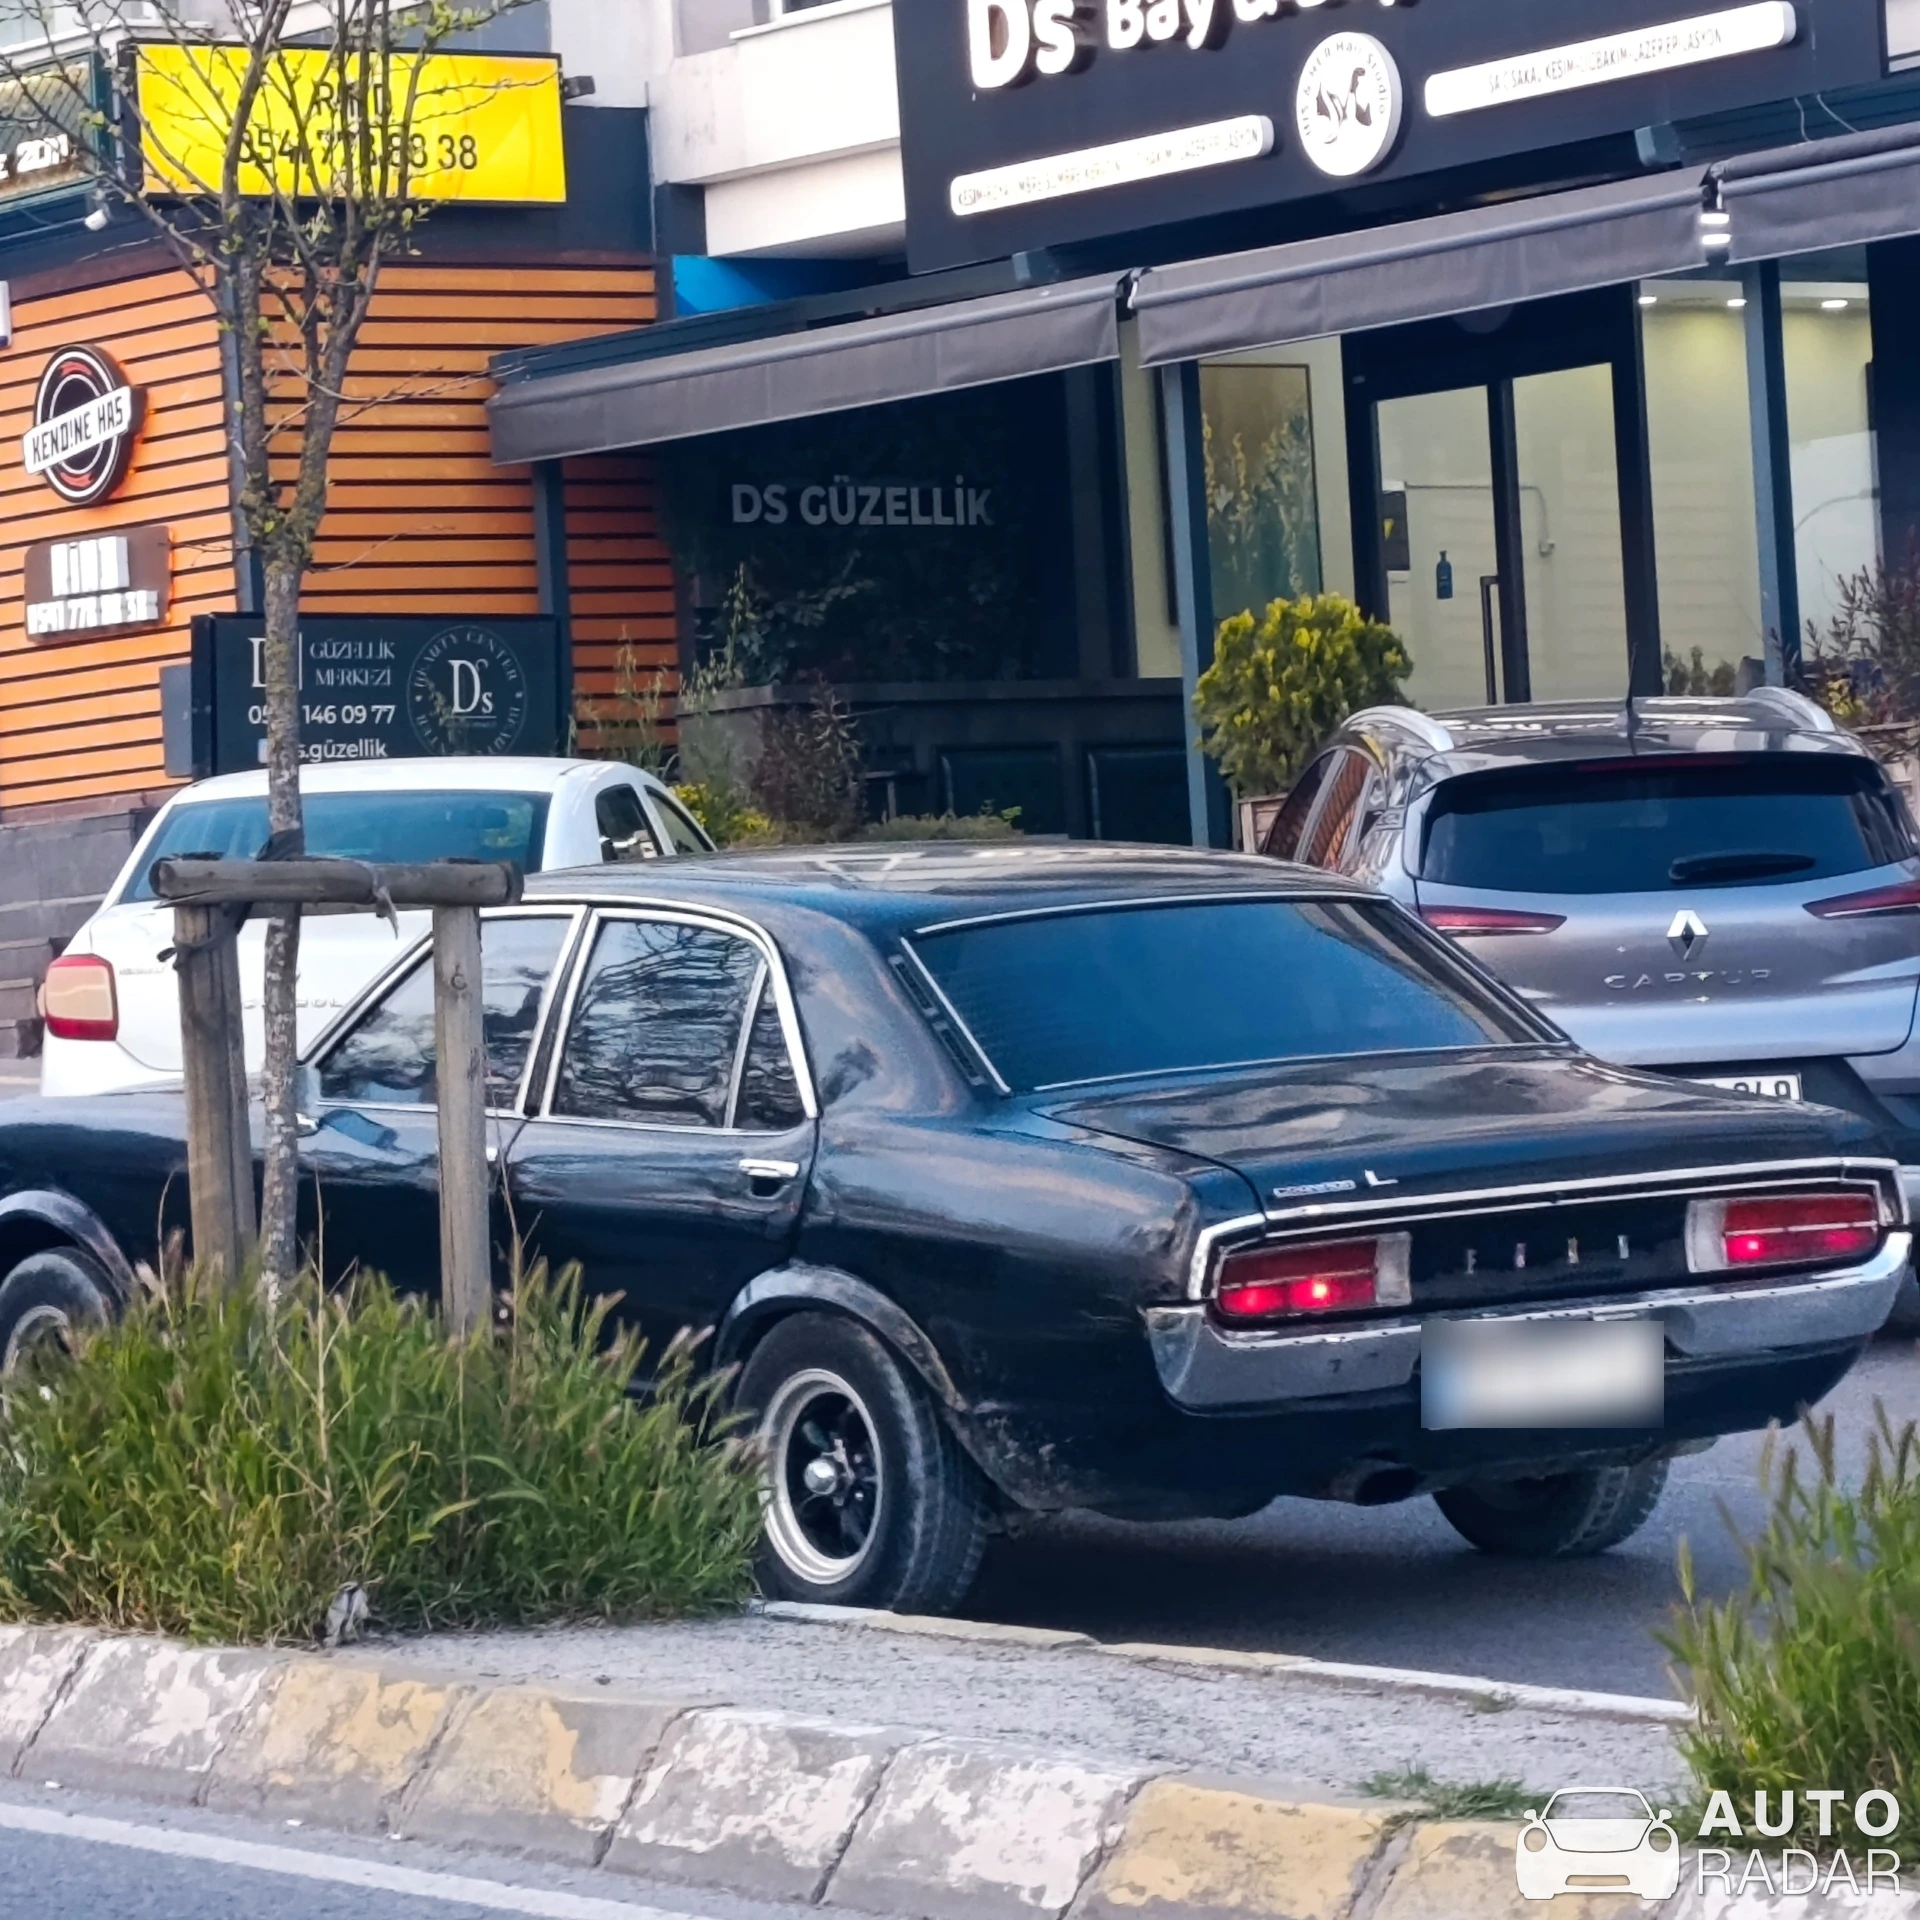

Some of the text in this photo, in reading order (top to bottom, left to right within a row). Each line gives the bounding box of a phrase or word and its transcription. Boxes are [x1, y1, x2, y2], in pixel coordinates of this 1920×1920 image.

[438, 134, 477, 169] 38
[97, 396, 123, 435] HAS
[731, 474, 995, 525] DS GÜZELLİK
[302, 704, 337, 725] 146
[341, 704, 367, 725] 09
[371, 704, 397, 725] 77
